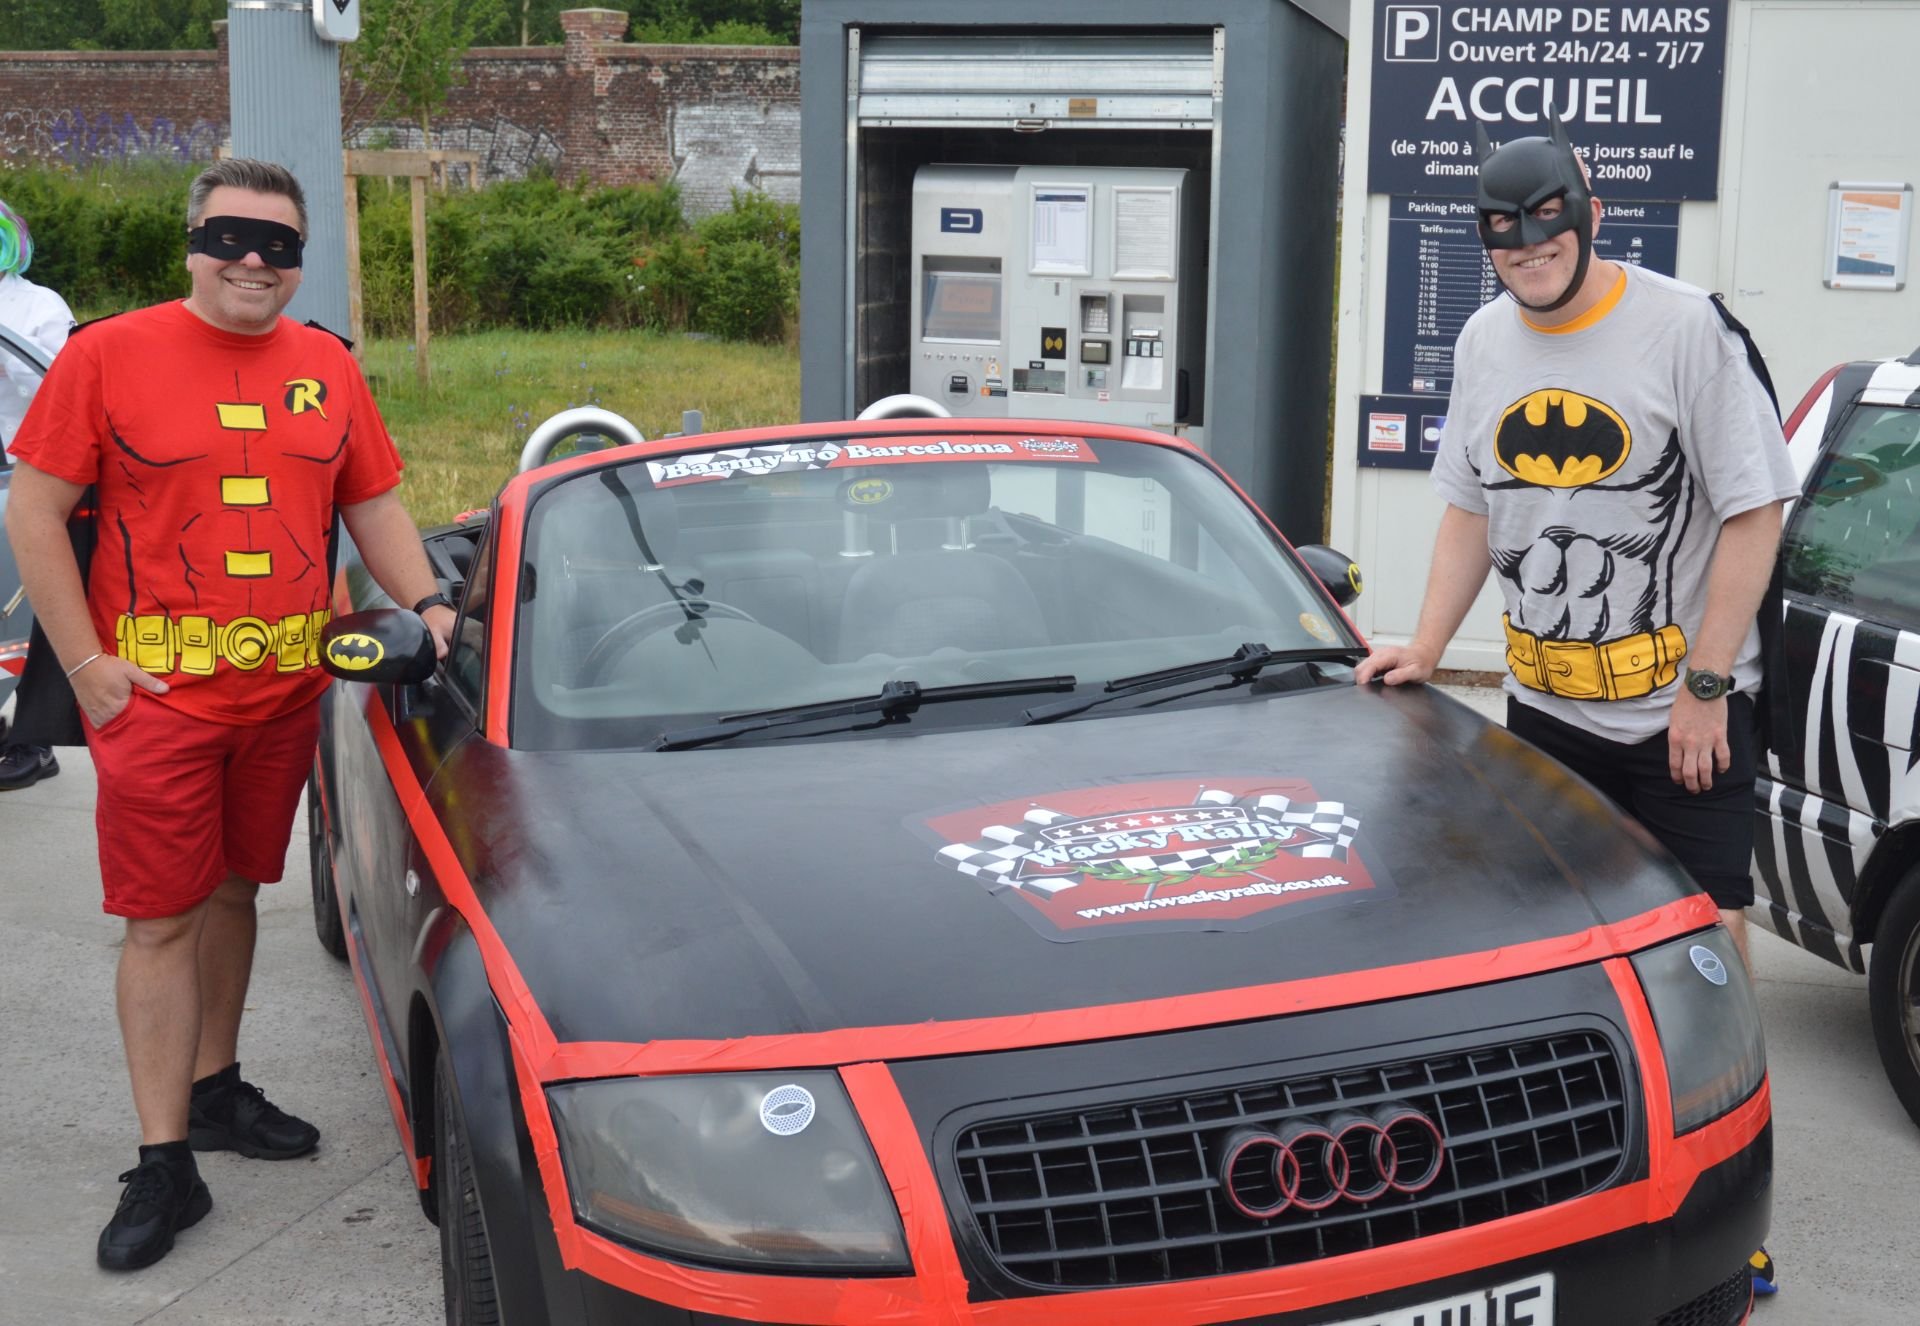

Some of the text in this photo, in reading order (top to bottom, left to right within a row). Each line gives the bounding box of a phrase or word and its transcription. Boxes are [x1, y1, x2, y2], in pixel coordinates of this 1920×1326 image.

[1394, 10, 1430, 57] P
[1451, 7, 1711, 33] CHAMP DE MARS
[1449, 40, 1536, 63] Ouvert
[1543, 40, 1631, 63] 24h/24
[1655, 41, 1705, 69] 7j/7
[1425, 76, 1662, 124] ACCUEIL
[1391, 139, 1417, 156] (de
[1420, 139, 1459, 155] 7h00
[1462, 141, 1473, 156] à
[1570, 143, 1695, 161] es jours sauf le
[1596, 164, 1652, 182] 20h00)
[1408, 202, 1476, 216] Parking Petit
[1607, 206, 1645, 217] Liberté
[1420, 224, 1444, 234] Tarifs
[283, 377, 329, 422] R
[663, 453, 782, 479] Barmy
[792, 448, 838, 463] To
[844, 441, 1014, 459] Barcelona
[1022, 819, 1298, 867] Wacky Rally
[1076, 874, 1350, 919] www.wackyrally.co.uk
